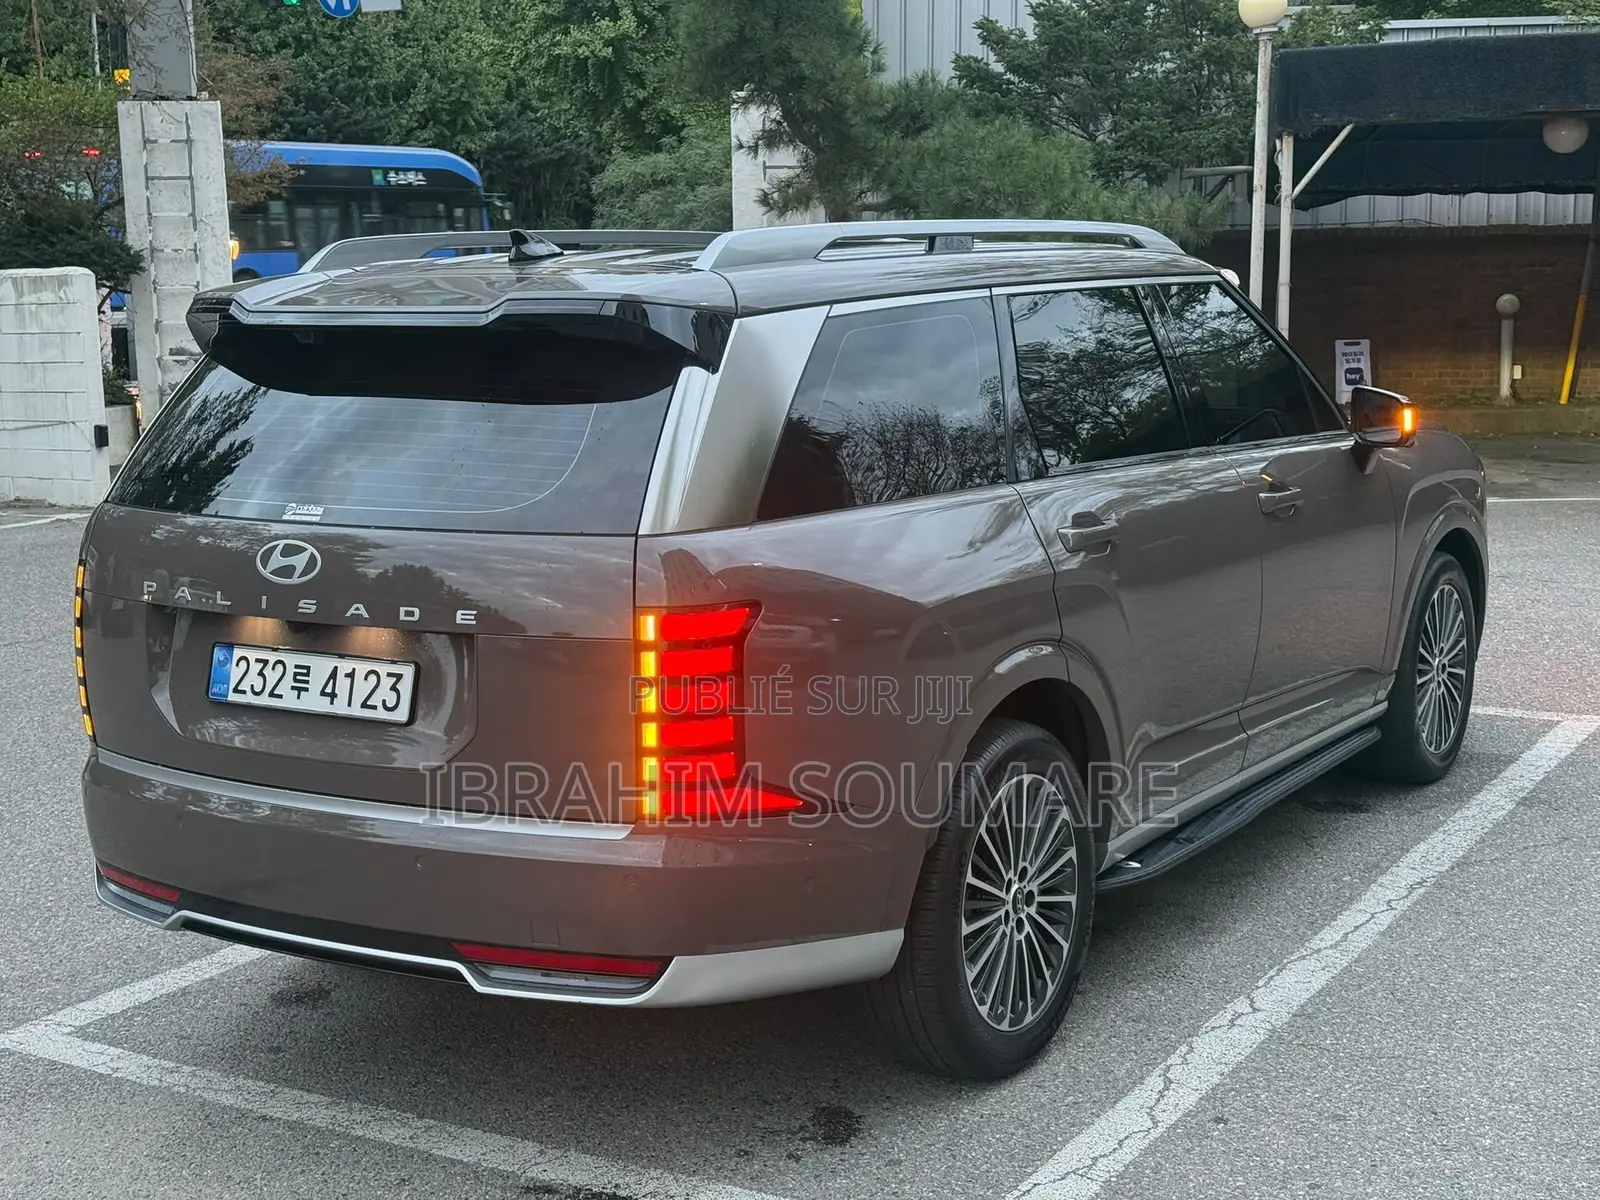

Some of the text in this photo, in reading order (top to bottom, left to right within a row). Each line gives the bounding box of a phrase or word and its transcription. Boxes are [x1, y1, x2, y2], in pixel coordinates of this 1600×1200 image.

[143, 580, 478, 625] PALISADE
[232, 655, 404, 712] 232루 4123
